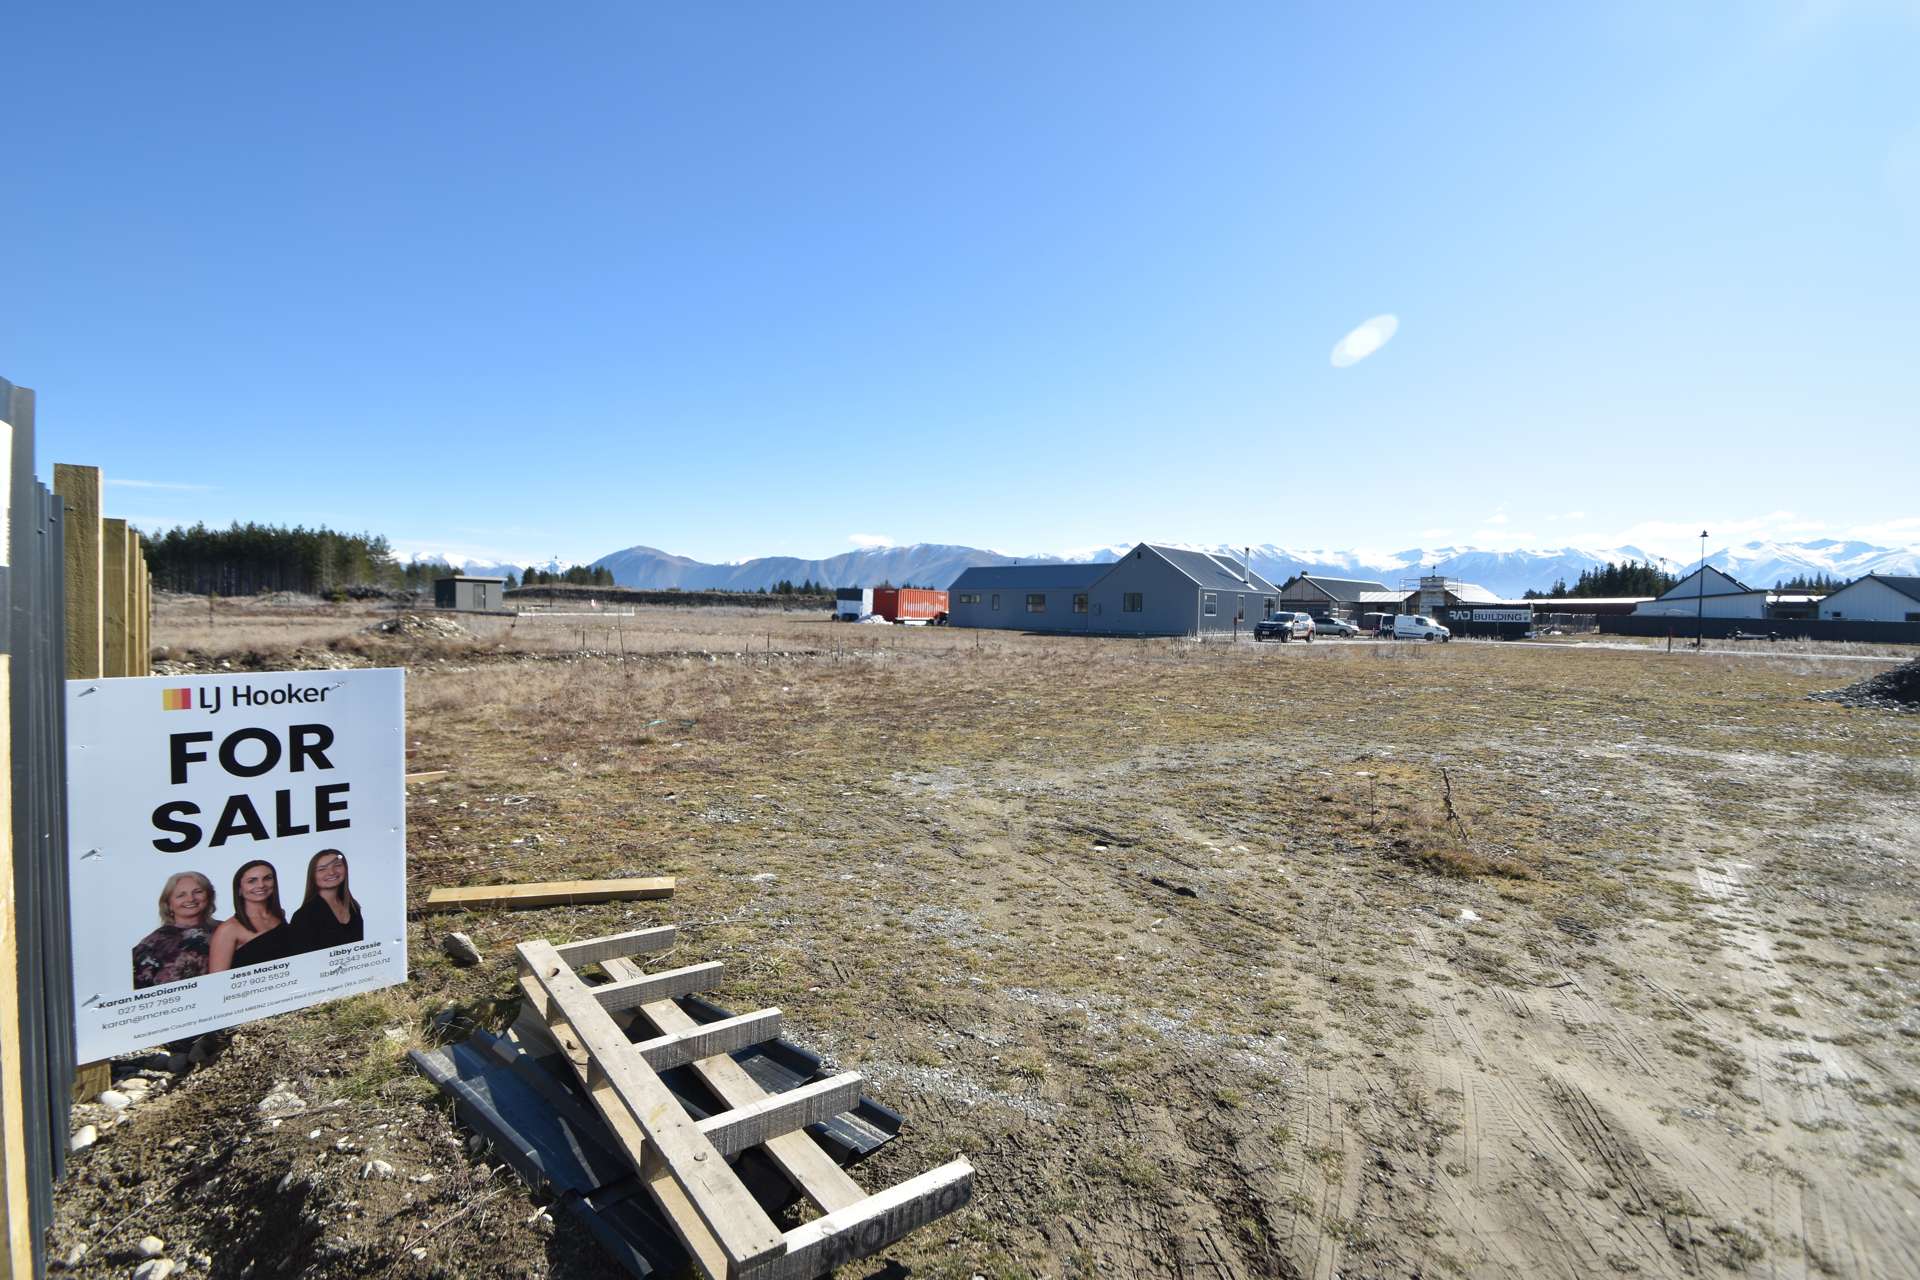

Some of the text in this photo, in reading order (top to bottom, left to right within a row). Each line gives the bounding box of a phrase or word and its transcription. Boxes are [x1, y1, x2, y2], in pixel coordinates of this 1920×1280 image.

[1474, 613, 1521, 621] BUILDING
[200, 683, 329, 714] LJ Hooker
[170, 723, 335, 784] FOR
[152, 782, 351, 853] SALE
[329, 941, 382, 958] Libby Cassie
[230, 961, 291, 980] Jess Mackay
[231, 970, 290, 990] 027 902 5529
[98, 981, 198, 1009] Karan MacDiarmid
[118, 995, 182, 1016] 027 517 7959
[102, 1003, 197, 1030] karan@mcre.co.nz
